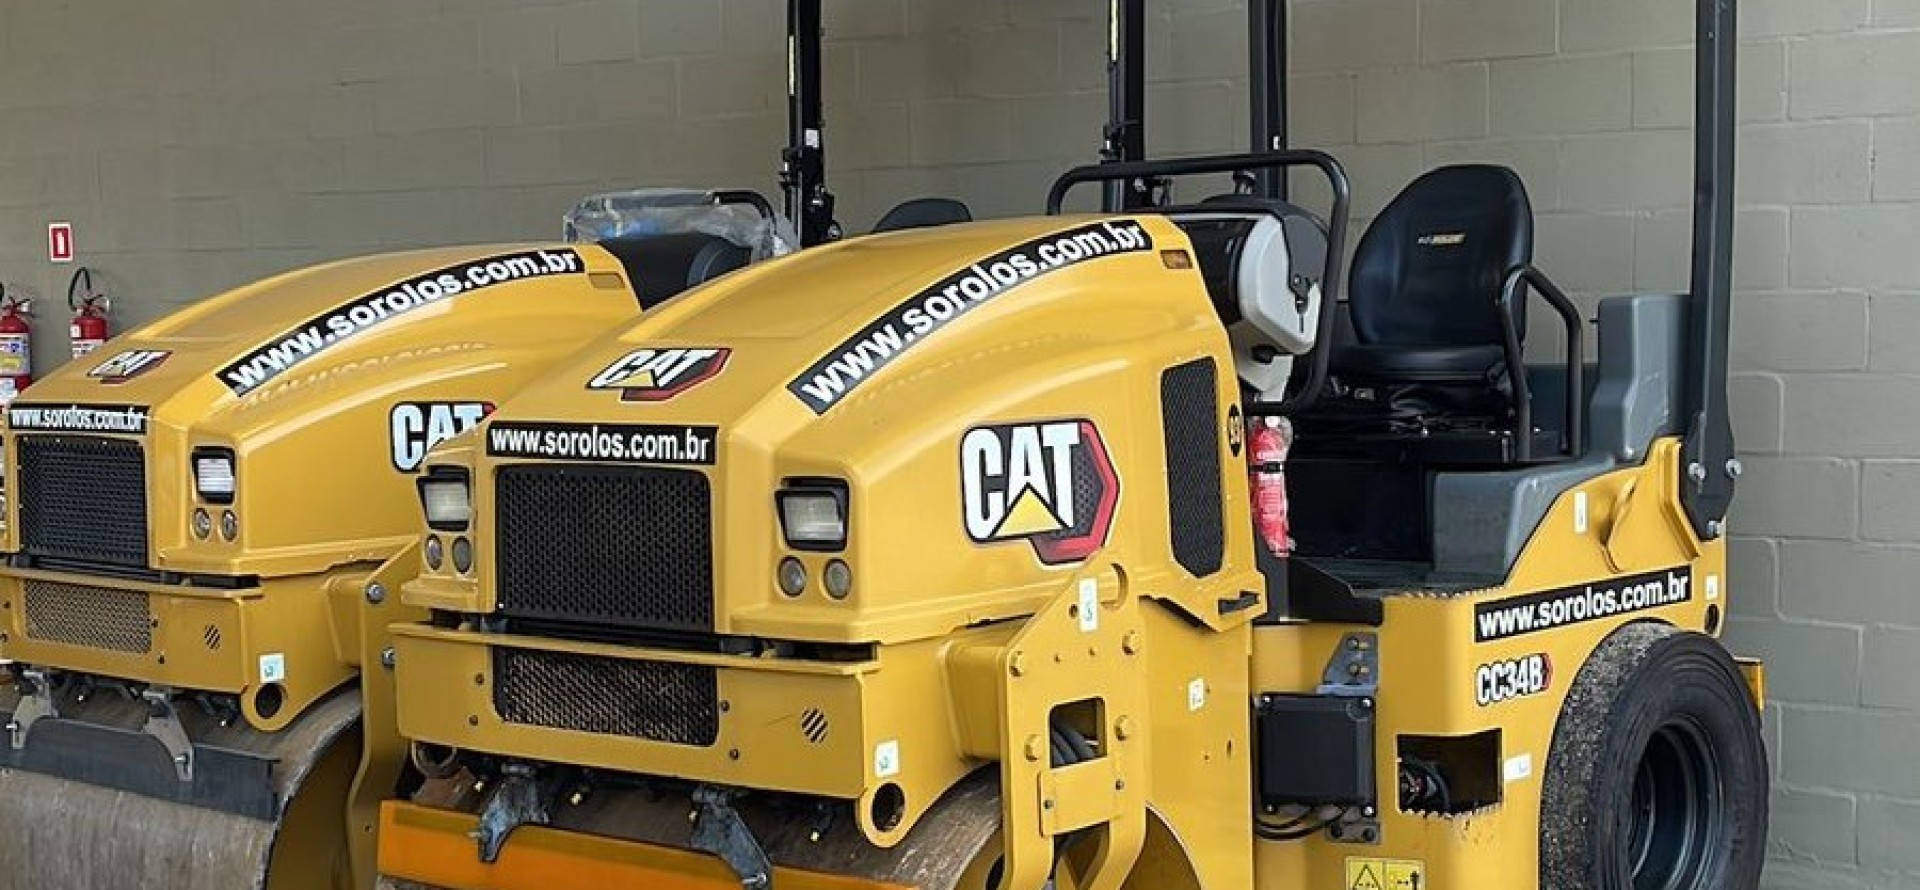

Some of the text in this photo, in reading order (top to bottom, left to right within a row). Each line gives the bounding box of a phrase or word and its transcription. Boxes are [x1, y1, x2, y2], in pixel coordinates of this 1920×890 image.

[228, 248, 578, 386] www.sorolos.com.br
[801, 219, 1146, 405] www.sorolos.com.br
[91, 351, 166, 376] CAT
[591, 349, 719, 388] CAT
[11, 405, 143, 431] www.sorolos.com.br
[491, 425, 710, 461] www.sorolos.com.br
[962, 423, 1080, 540] CAT
[1479, 572, 1688, 636] www.sorolos.com.br
[1478, 655, 1543, 704] CC34B
